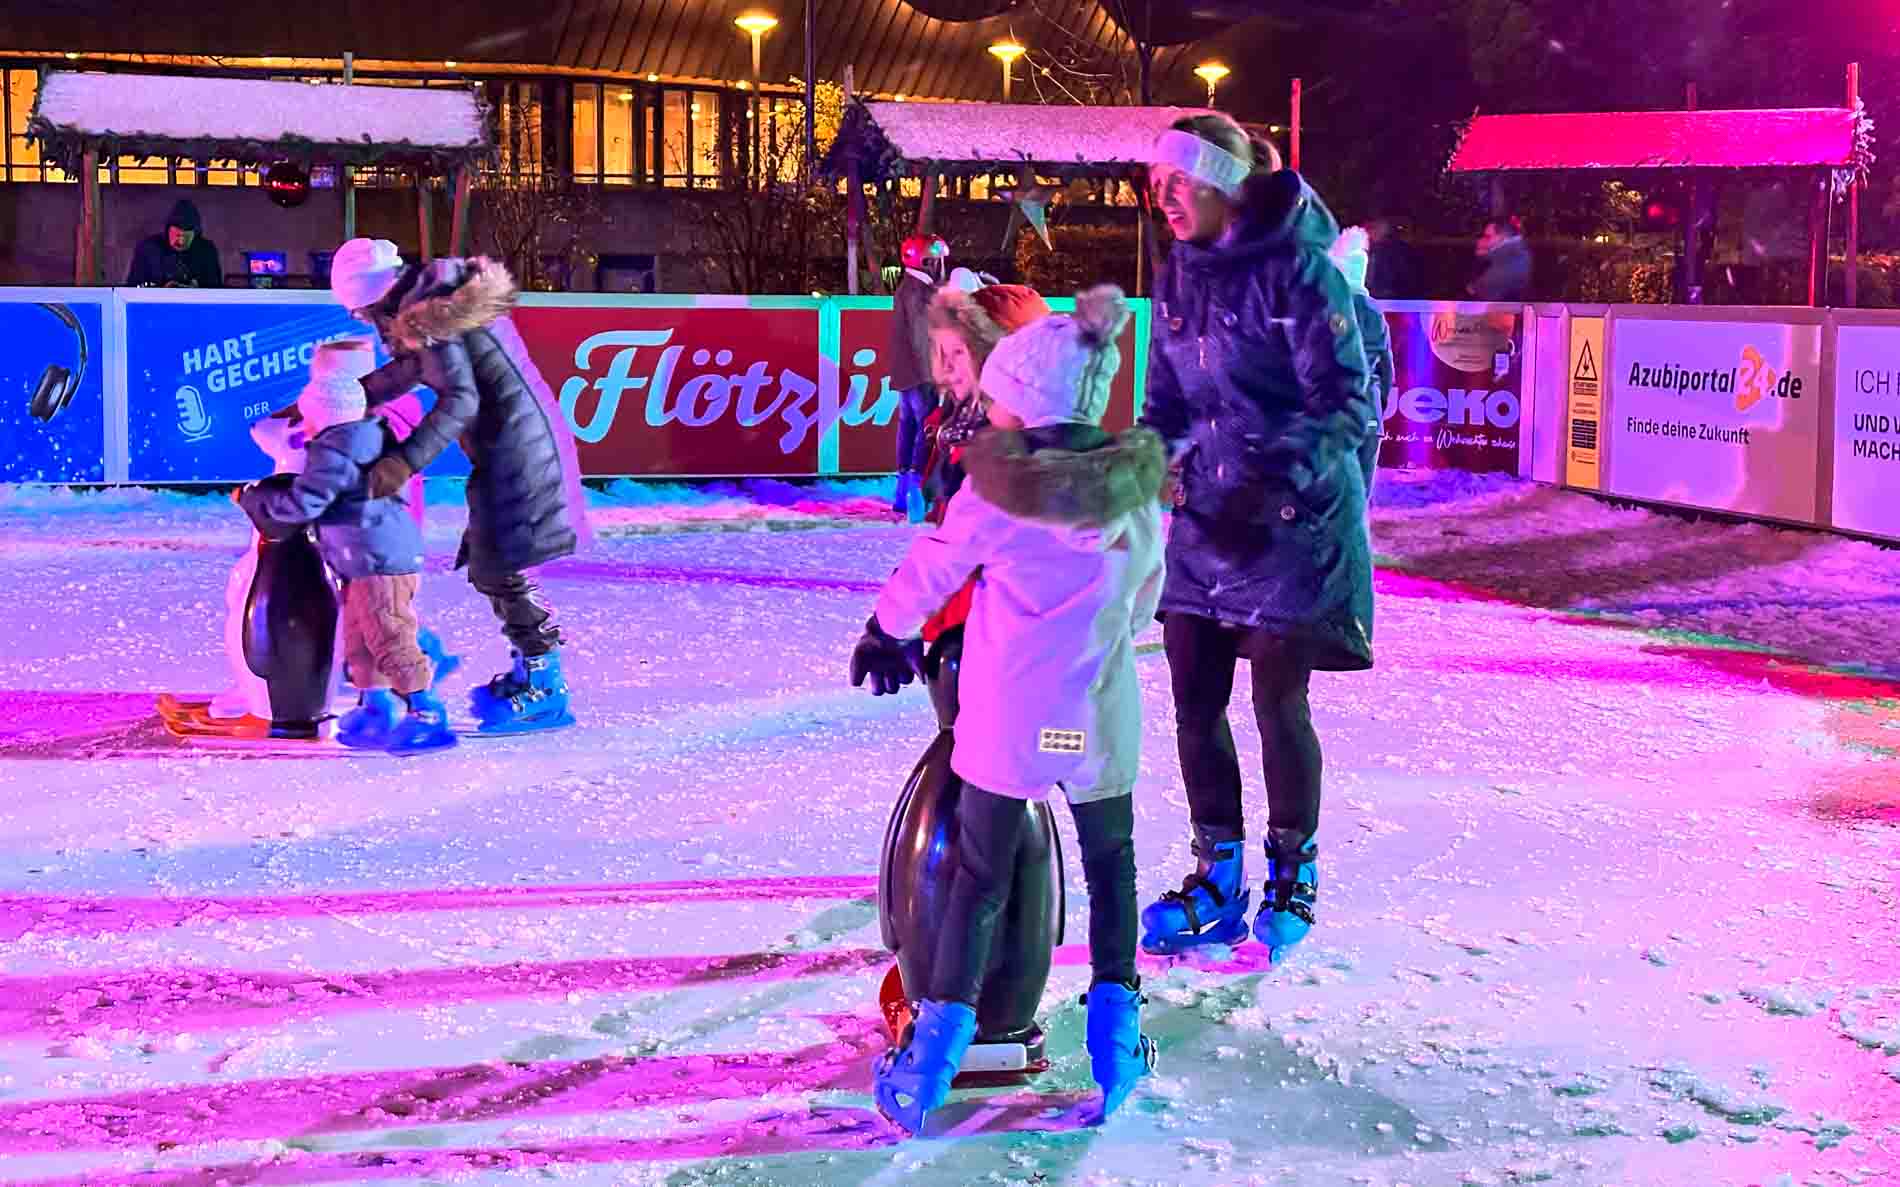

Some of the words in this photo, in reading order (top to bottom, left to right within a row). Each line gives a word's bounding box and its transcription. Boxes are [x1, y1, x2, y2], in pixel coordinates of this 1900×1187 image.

[182, 332, 257, 375] HART
[207, 331, 353, 393] GECHEC
[1855, 369, 1890, 393] ICH
[244, 401, 270, 420] DER
[1854, 413, 1890, 432] UND
[1627, 416, 1660, 435] Finde
[1662, 420, 1697, 440] deine
[1699, 423, 1750, 445] Zukunft
